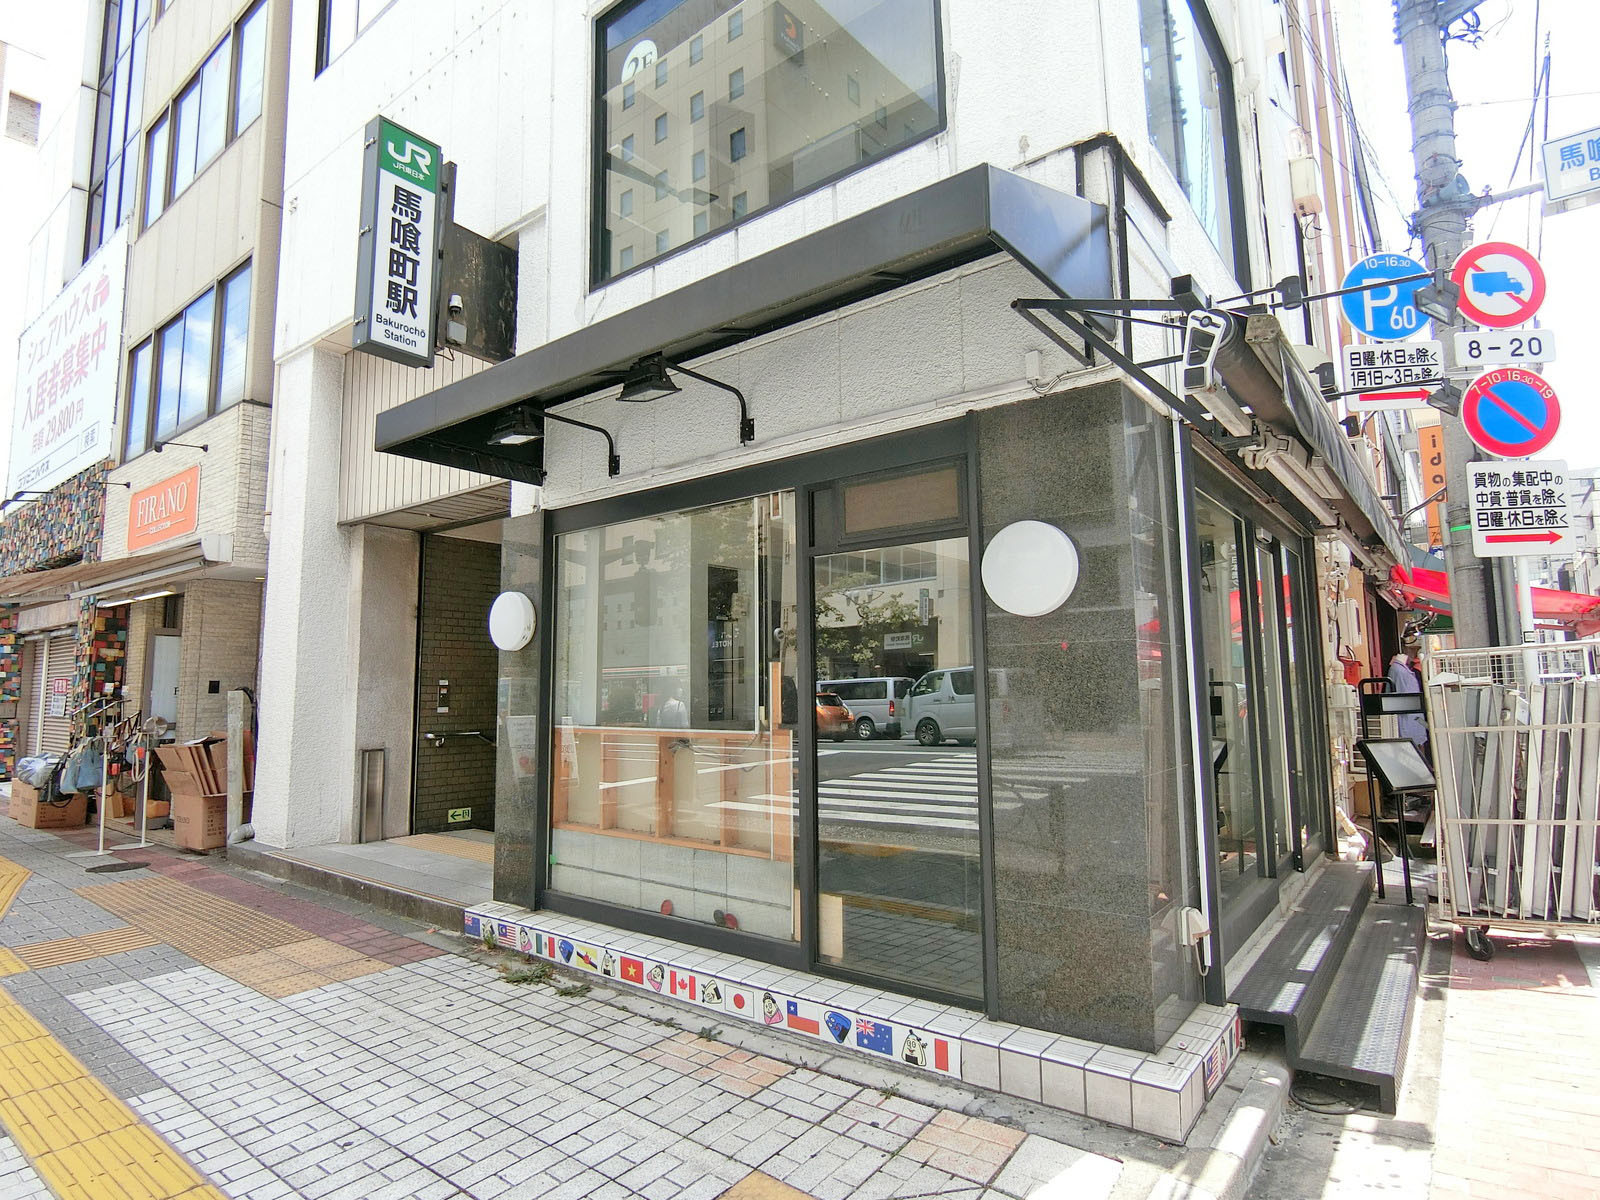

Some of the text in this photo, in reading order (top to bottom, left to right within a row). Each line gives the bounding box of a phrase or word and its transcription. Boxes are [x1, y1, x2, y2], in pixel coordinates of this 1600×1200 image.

[387, 140, 432, 176] JR
[385, 184, 423, 320] 馬喰町駅
[1361, 277, 1417, 332] P 60
[27, 281, 91, 375] シェアハウス
[384, 328, 418, 348] Station
[22, 316, 109, 431] 入居者募集中
[1350, 347, 1439, 367] 日曜・休日を除く
[1473, 469, 1563, 489] 貨物の集配中の
[135, 481, 188, 528] FIRANO
[1475, 488, 1566, 508] 中貨・普貨を除く
[1477, 508, 1568, 528] 日曜・休日を除く
